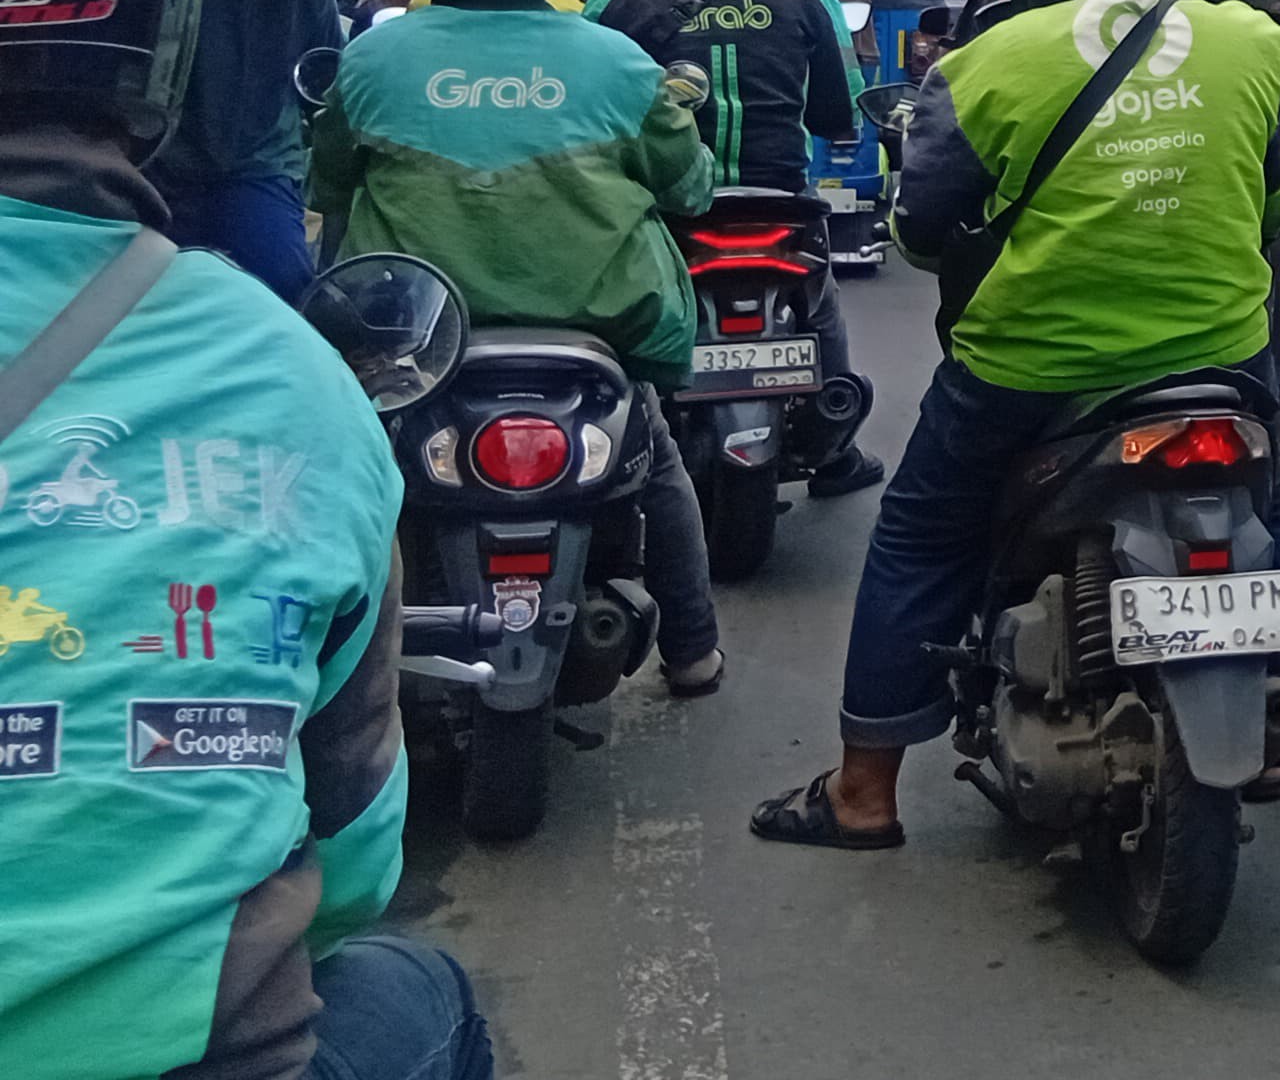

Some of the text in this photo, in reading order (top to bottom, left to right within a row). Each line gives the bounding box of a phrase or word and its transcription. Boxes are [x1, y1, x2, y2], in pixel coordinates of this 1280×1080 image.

[425, 66, 566, 109] Grab
[1093, 79, 1204, 128] gojek
[1095, 130, 1205, 158] tokopedia
[1121, 166, 1187, 190] gopay
[703, 347, 757, 371] 3352
[1121, 588, 1138, 622] B
[1159, 583, 1235, 619] 3410
[8, 713, 44, 733] the
[174, 707, 248, 723] GET IT ON
